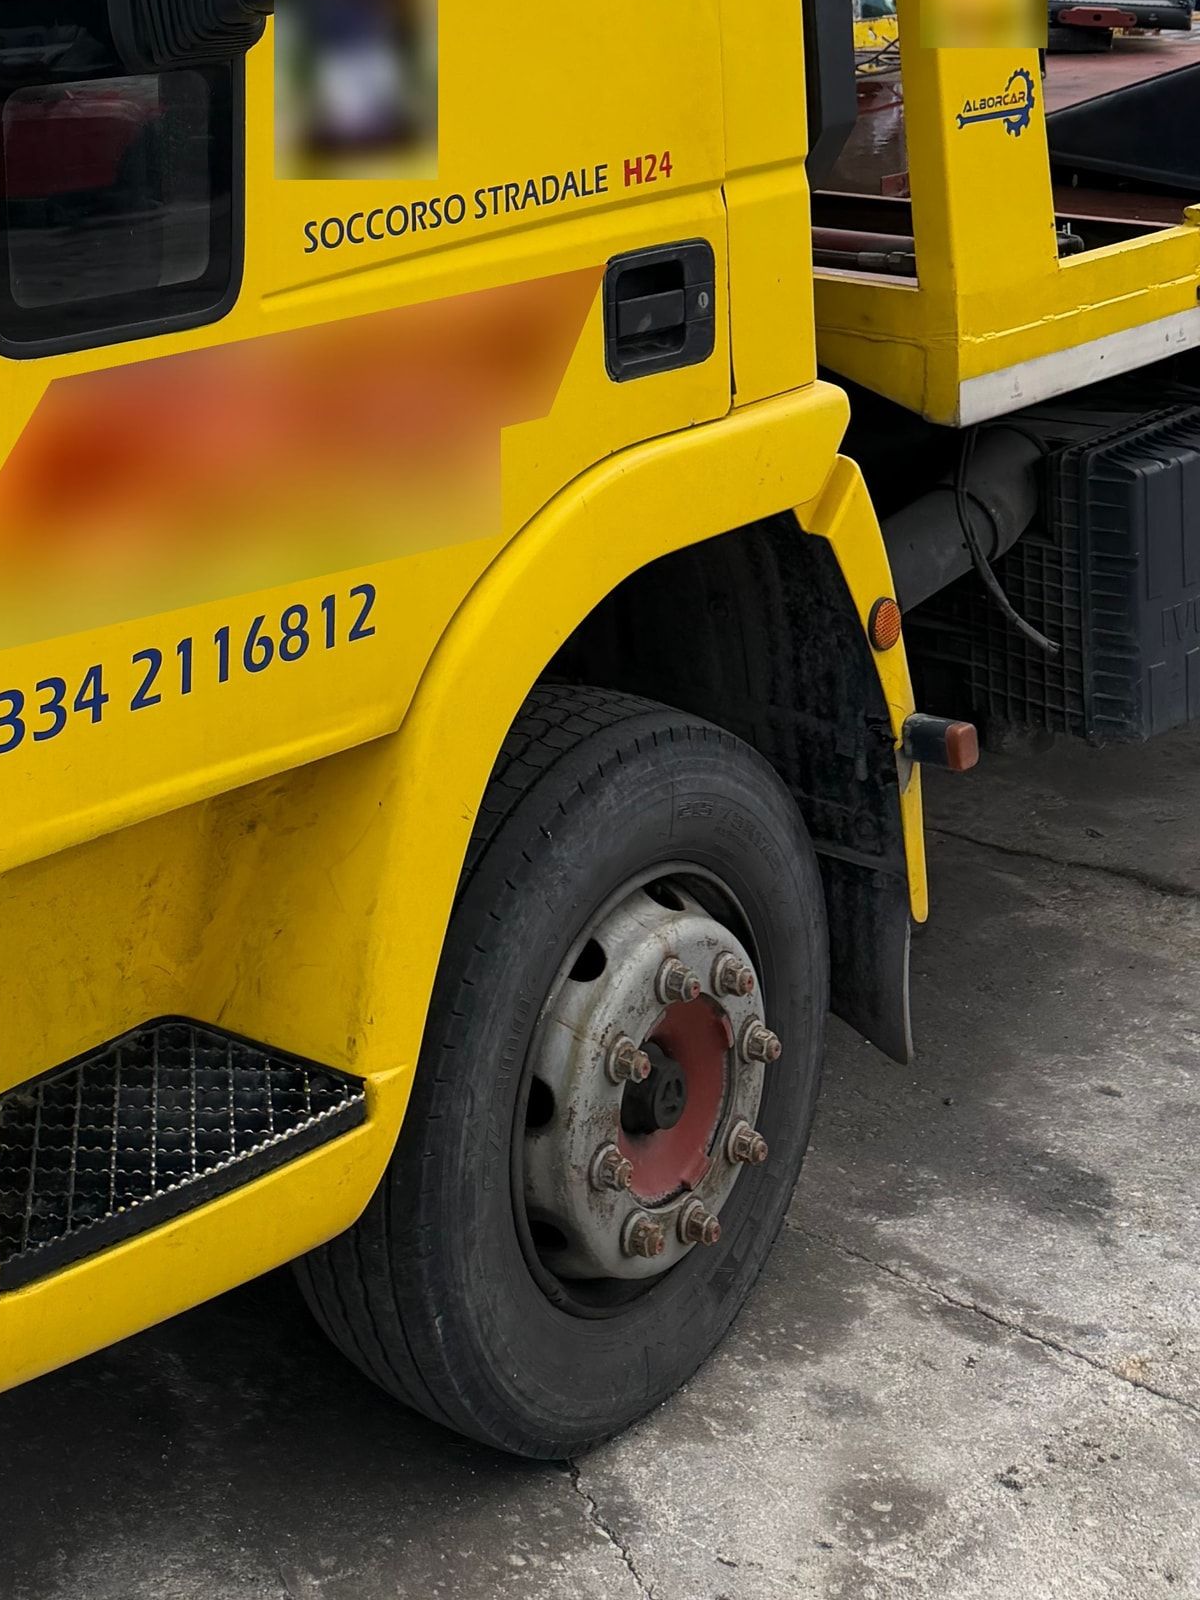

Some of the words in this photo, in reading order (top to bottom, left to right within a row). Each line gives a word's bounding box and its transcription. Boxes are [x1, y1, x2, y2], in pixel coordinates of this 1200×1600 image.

[962, 90, 1026, 114] ALBORCAR
[303, 193, 466, 254] SOCCORSO
[474, 163, 609, 220] STRADALE
[623, 150, 673, 188] H24
[129, 582, 377, 712] 2116812
